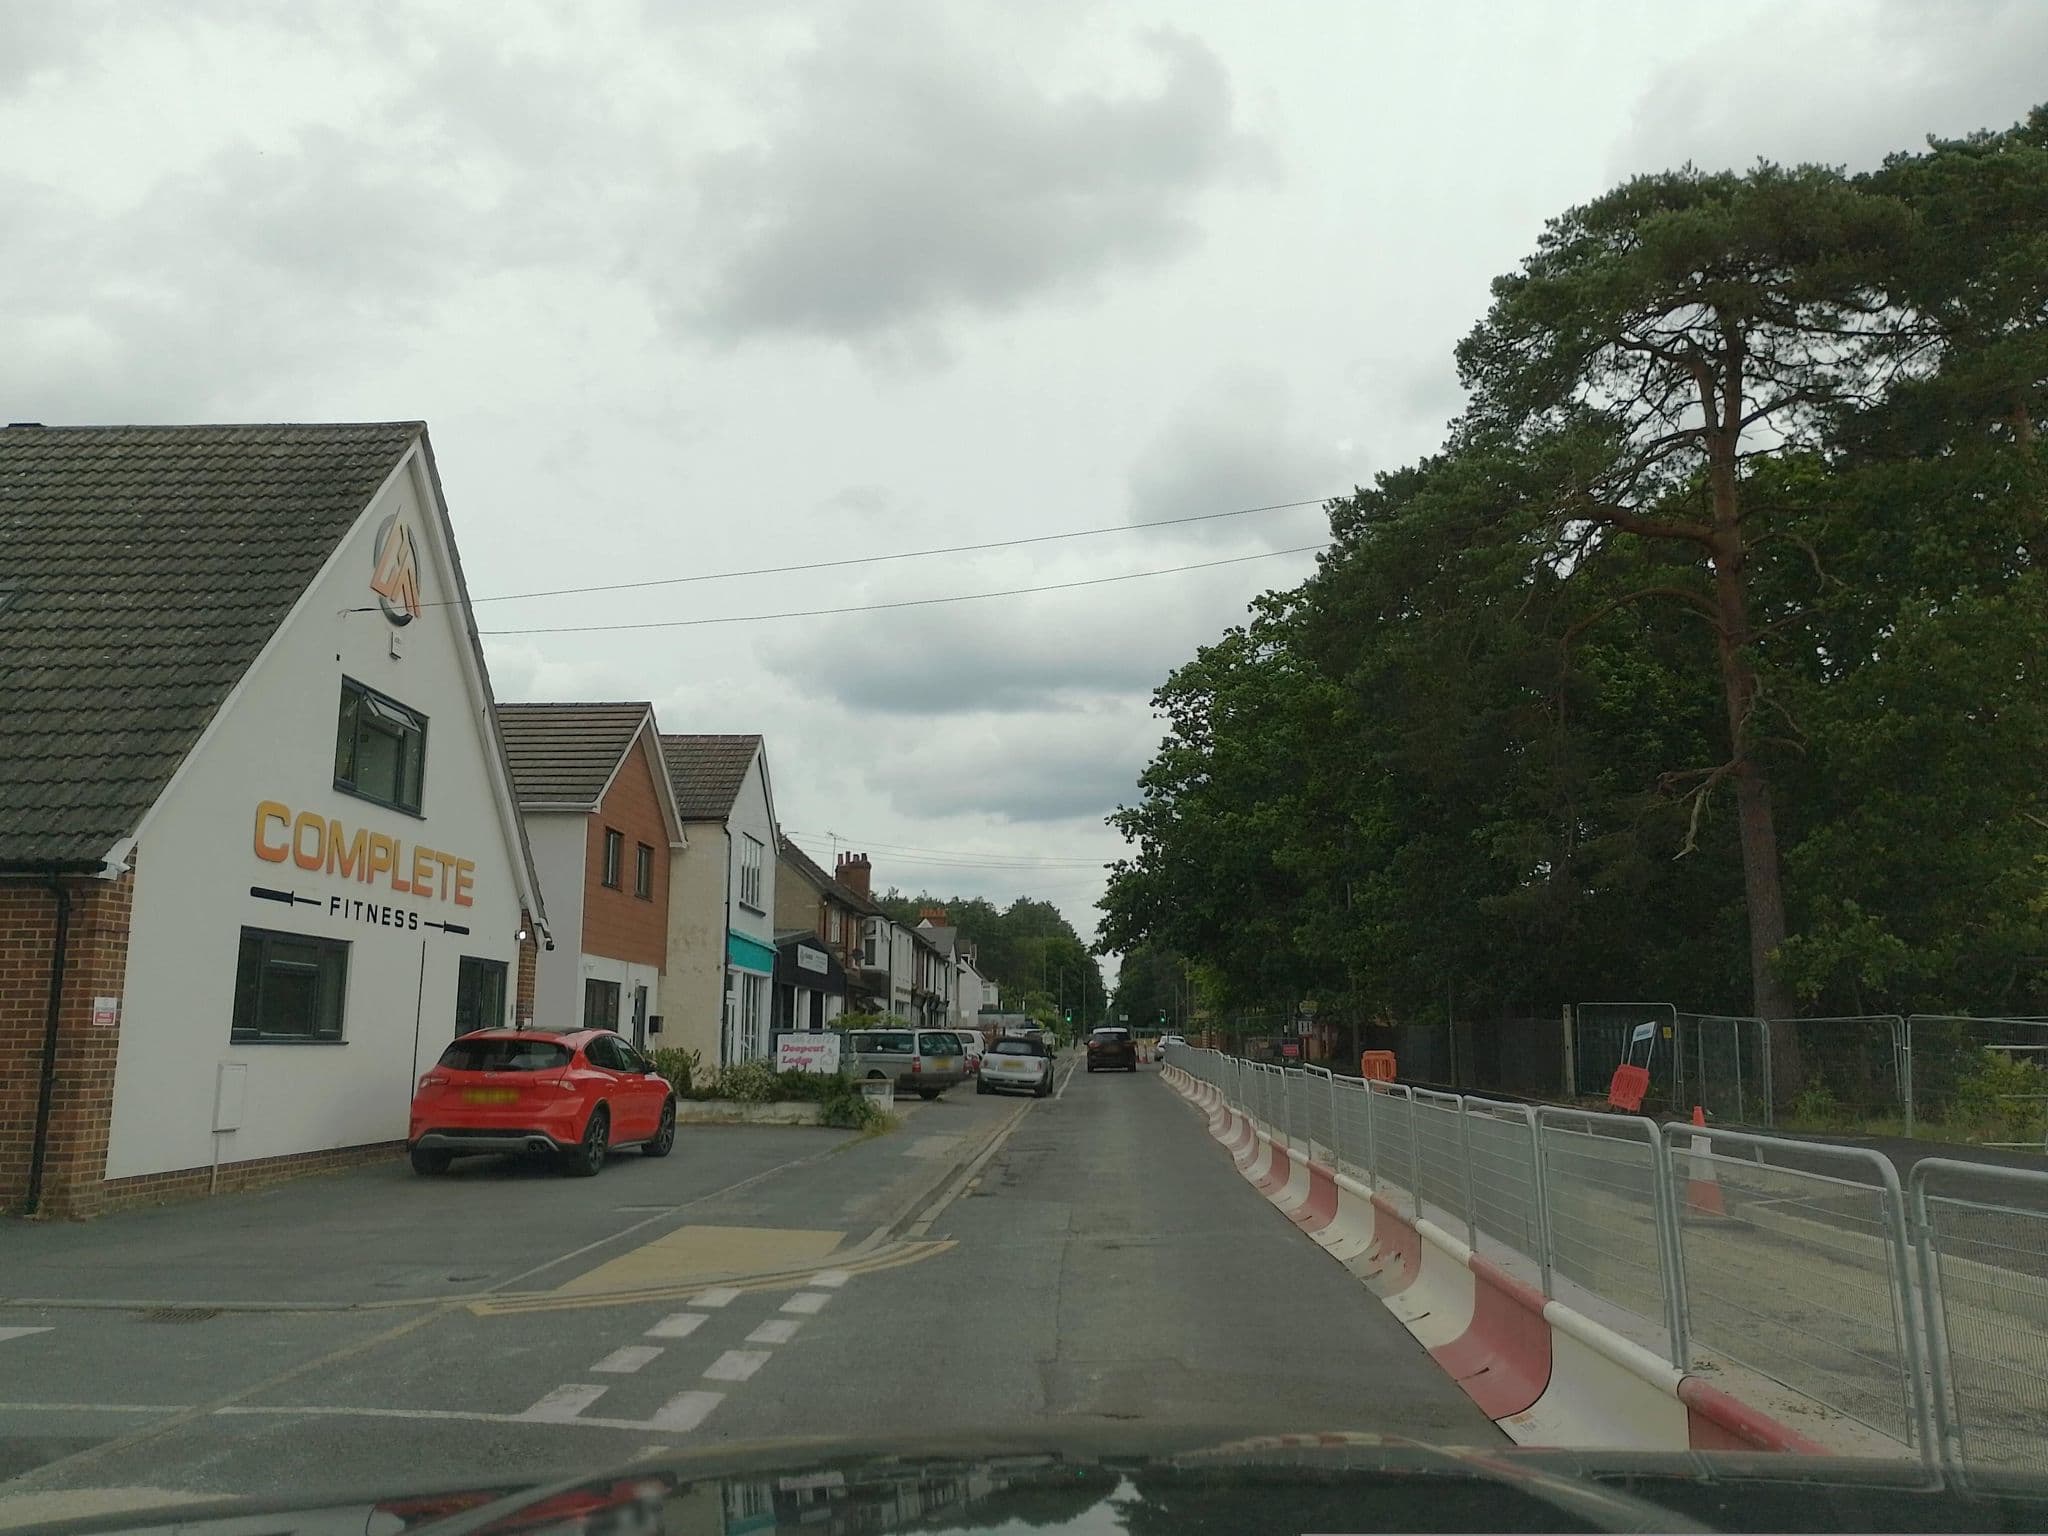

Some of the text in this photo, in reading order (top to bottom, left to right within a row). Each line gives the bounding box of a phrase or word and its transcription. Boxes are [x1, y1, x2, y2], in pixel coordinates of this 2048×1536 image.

[254, 800, 476, 907] COMPLETE
[329, 896, 418, 930] FITNESS
[781, 1056, 813, 1065] Lodge
